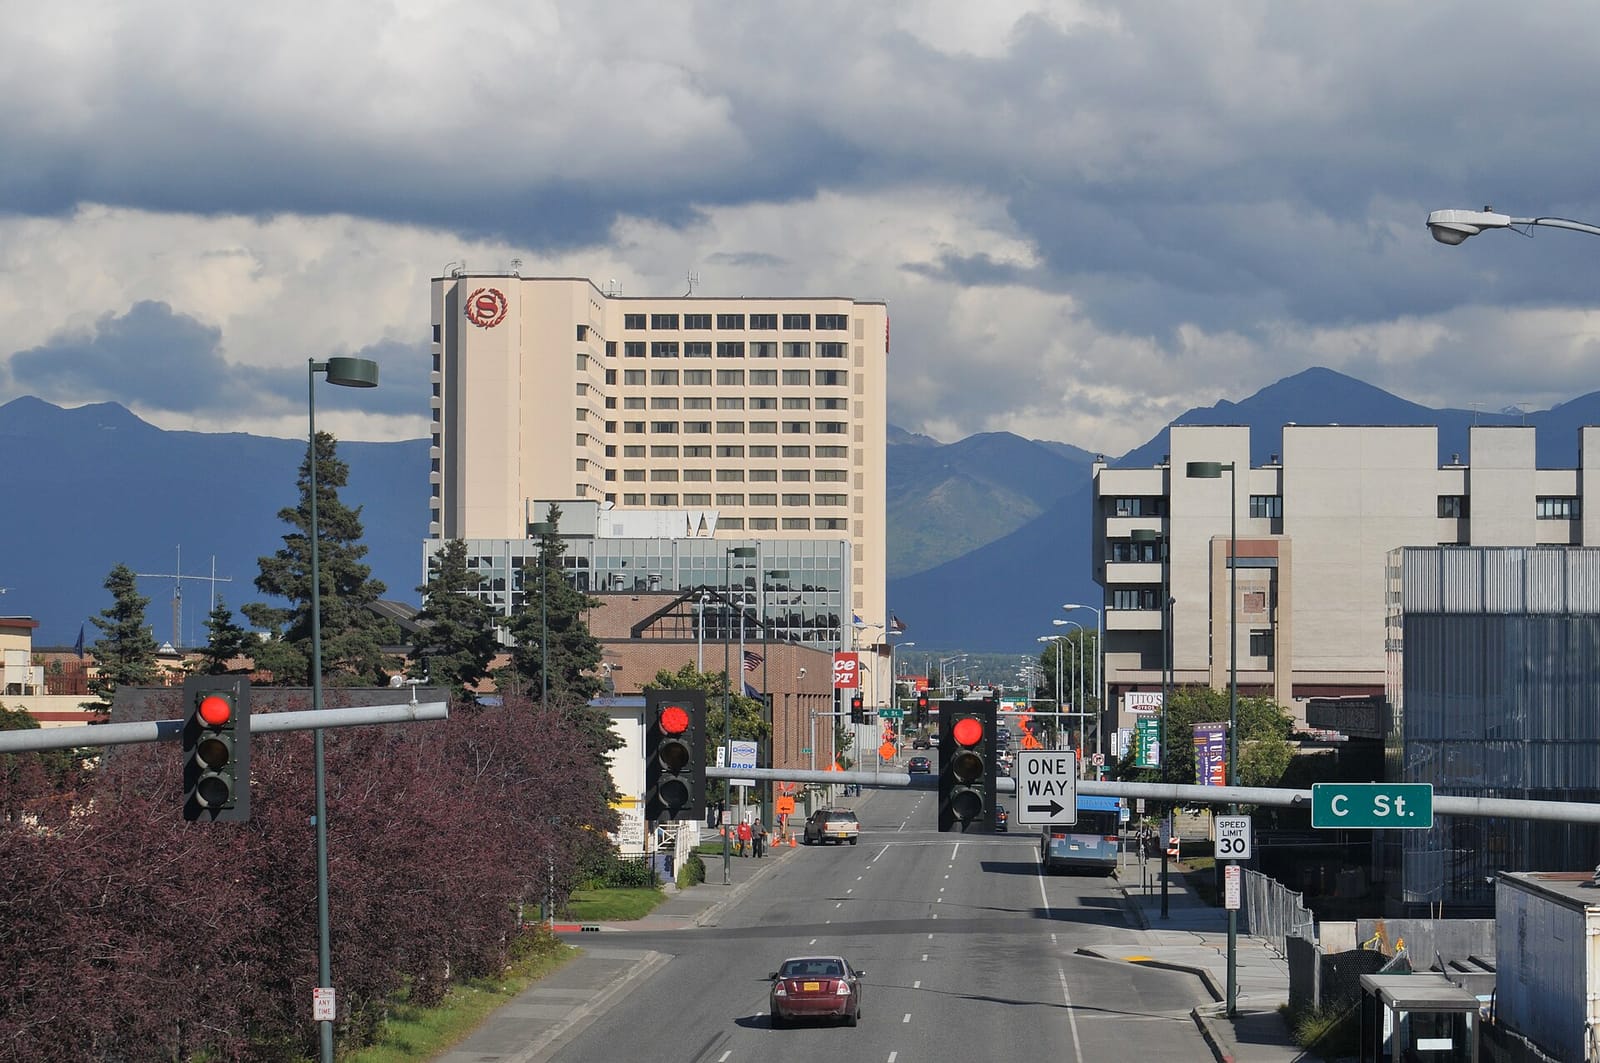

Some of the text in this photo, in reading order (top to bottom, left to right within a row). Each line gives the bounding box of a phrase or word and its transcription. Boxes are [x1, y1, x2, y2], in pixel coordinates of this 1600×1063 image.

[1129, 694, 1162, 704] TITO'S
[1209, 732, 1223, 783] MUSEU
[1028, 759, 1067, 775] ONE
[1028, 780, 1068, 796] WAY
[1331, 794, 1415, 817] C St.
[1219, 821, 1246, 829] SPEED
[1220, 838, 1245, 853] 30
